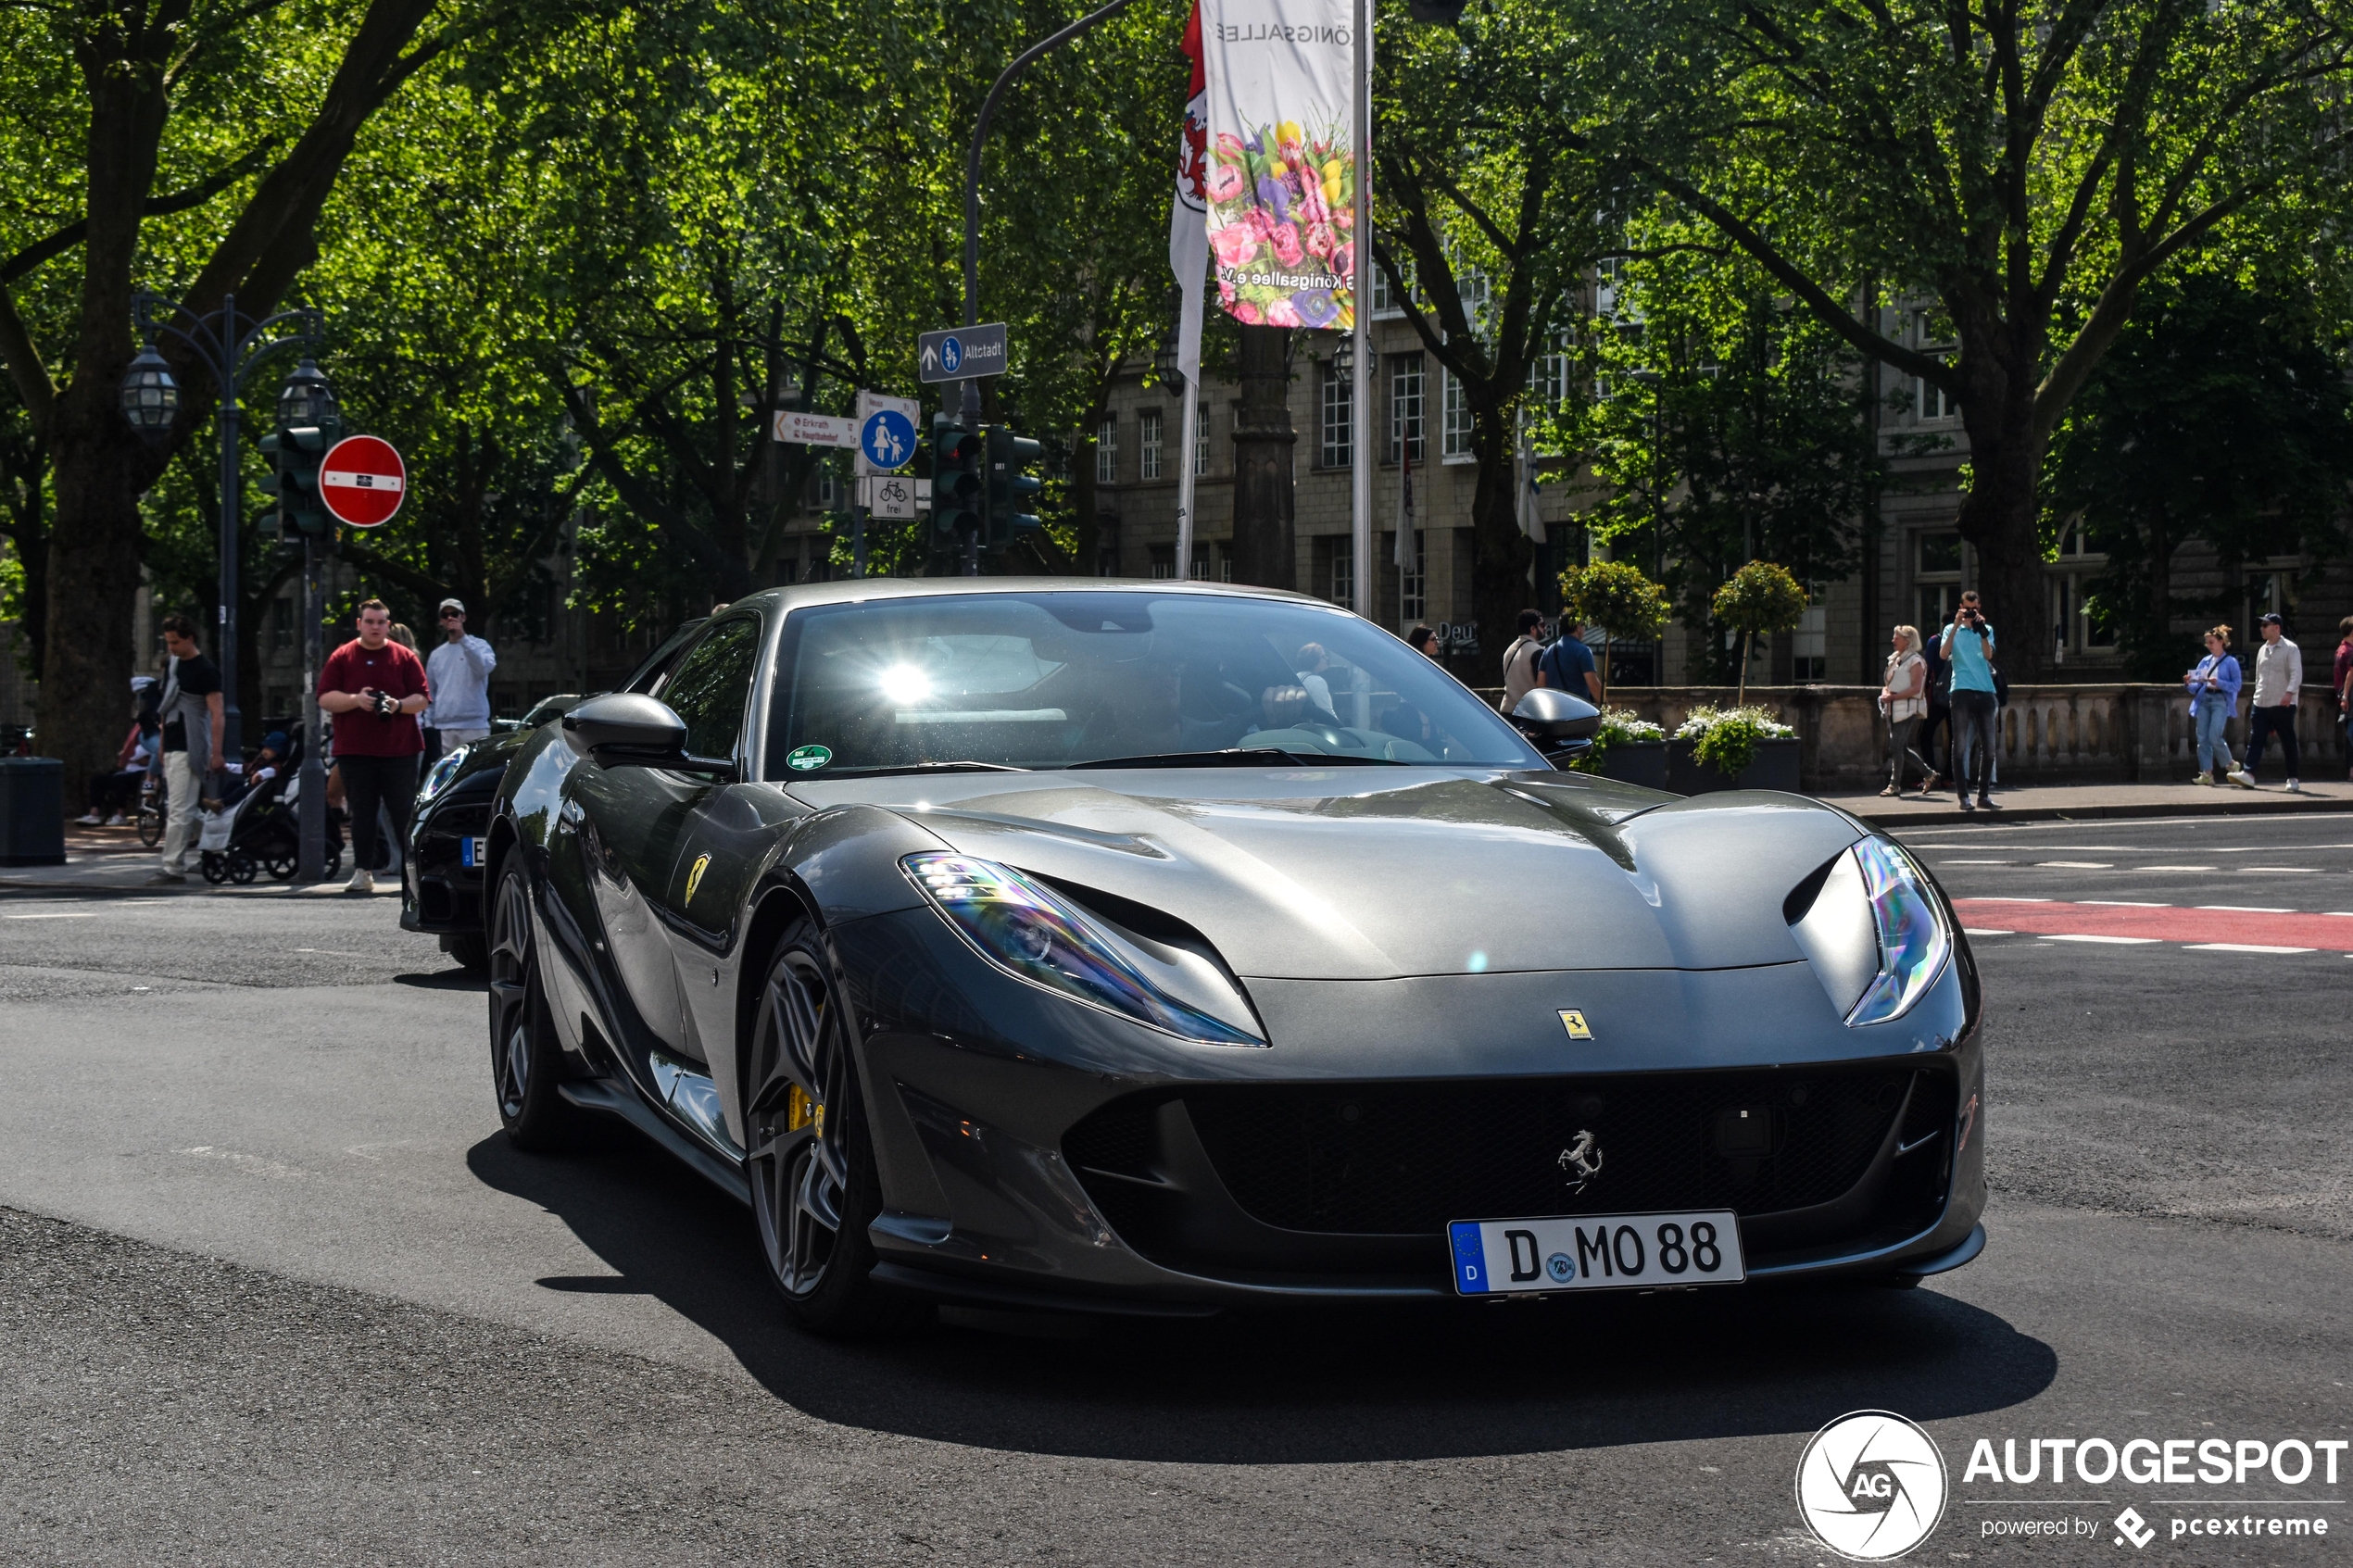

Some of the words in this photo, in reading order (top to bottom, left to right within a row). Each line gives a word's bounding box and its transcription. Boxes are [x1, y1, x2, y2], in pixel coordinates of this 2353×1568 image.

[964, 342, 1001, 359] Altstadt
[802, 418, 829, 430] Erkrath
[802, 431, 838, 443] Hauptbahnhof
[887, 504, 901, 514] frei
[803, 746, 816, 758] 4
[1504, 1229, 1541, 1283] D
[1575, 1224, 1645, 1278] MO
[1656, 1221, 1722, 1275] 88
[1466, 1265, 1478, 1281] D
